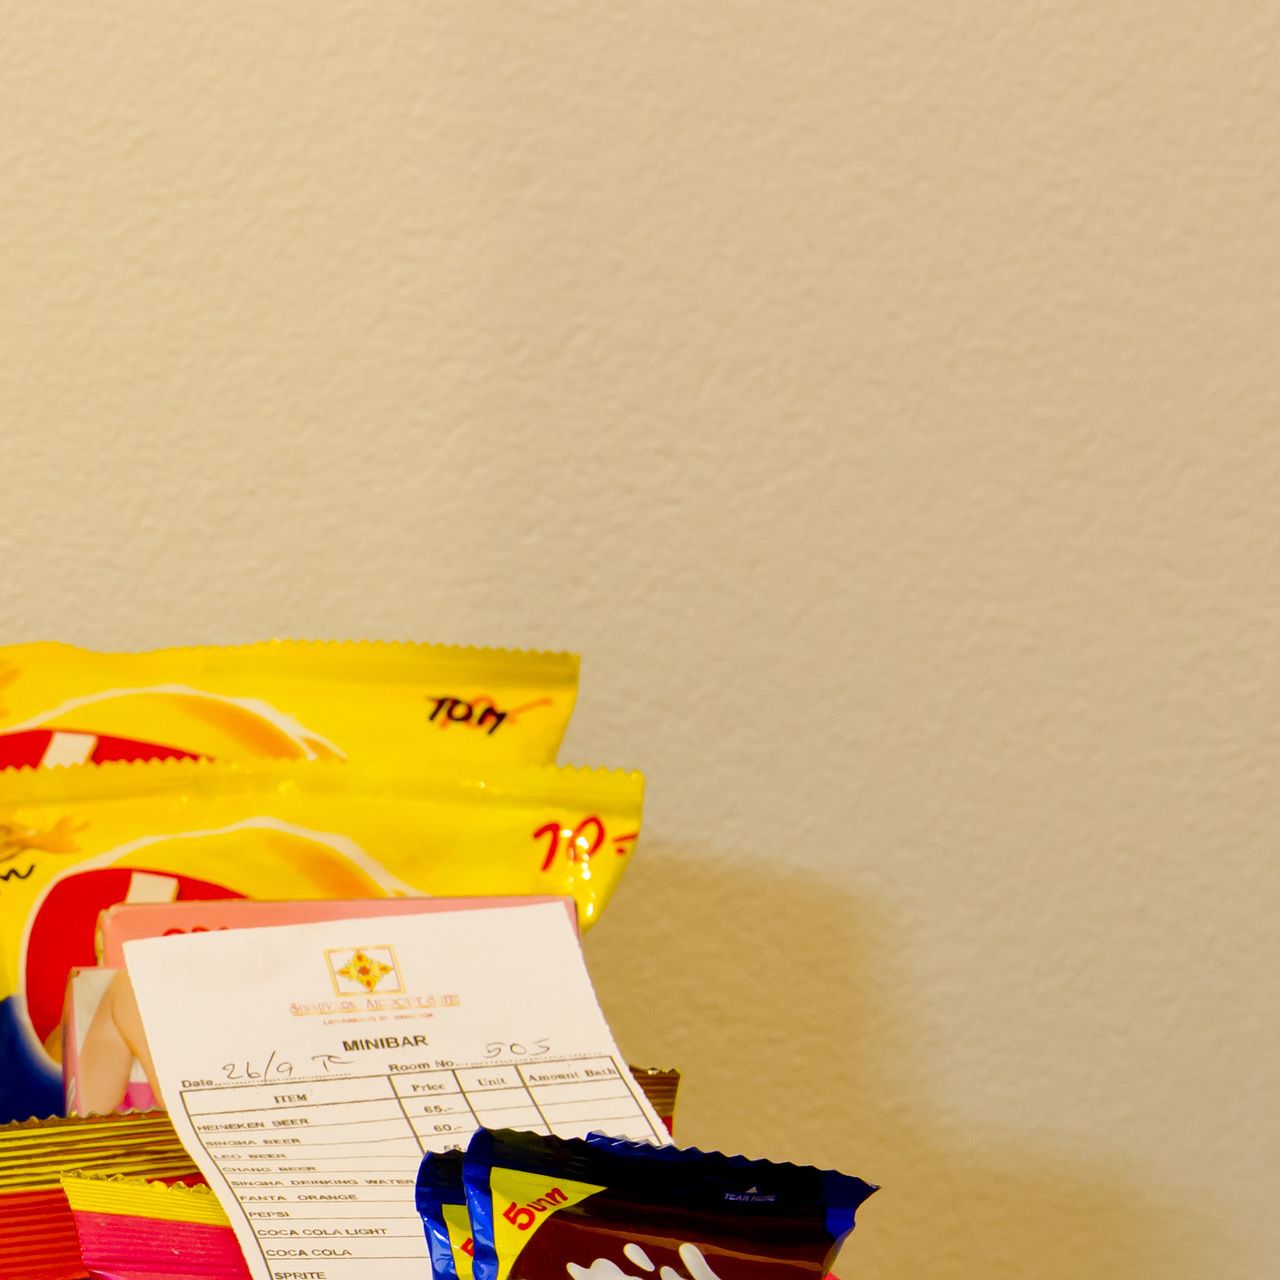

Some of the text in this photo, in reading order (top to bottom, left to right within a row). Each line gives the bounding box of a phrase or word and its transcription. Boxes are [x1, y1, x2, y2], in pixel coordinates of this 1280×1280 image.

[342, 1033, 429, 1052] MINIBAR
[389, 1061, 430, 1073] Room
[528, 1066, 617, 1083] Amount Bath
[181, 1077, 214, 1089] Date
[477, 1076, 507, 1087] Unit
[411, 1081, 446, 1093] Price
[274, 1093, 308, 1105] ITEM
[197, 1117, 310, 1132] HEINEKEN BEER
[205, 1137, 301, 1147] SINGHA BEER
[248, 1152, 287, 1160] BEER
[222, 1165, 318, 1173] CHANG BEER
[231, 1179, 283, 1187] SINGHA
[290, 1178, 359, 1186] DRINKING
[239, 1193, 359, 1202] FANTA ORANGE
[248, 1210, 291, 1218] PEPSI
[256, 1227, 390, 1236] COCA COLA LIGHT
[266, 1248, 353, 1257] COCA COLA
[274, 1271, 328, 1280] SPRITE
